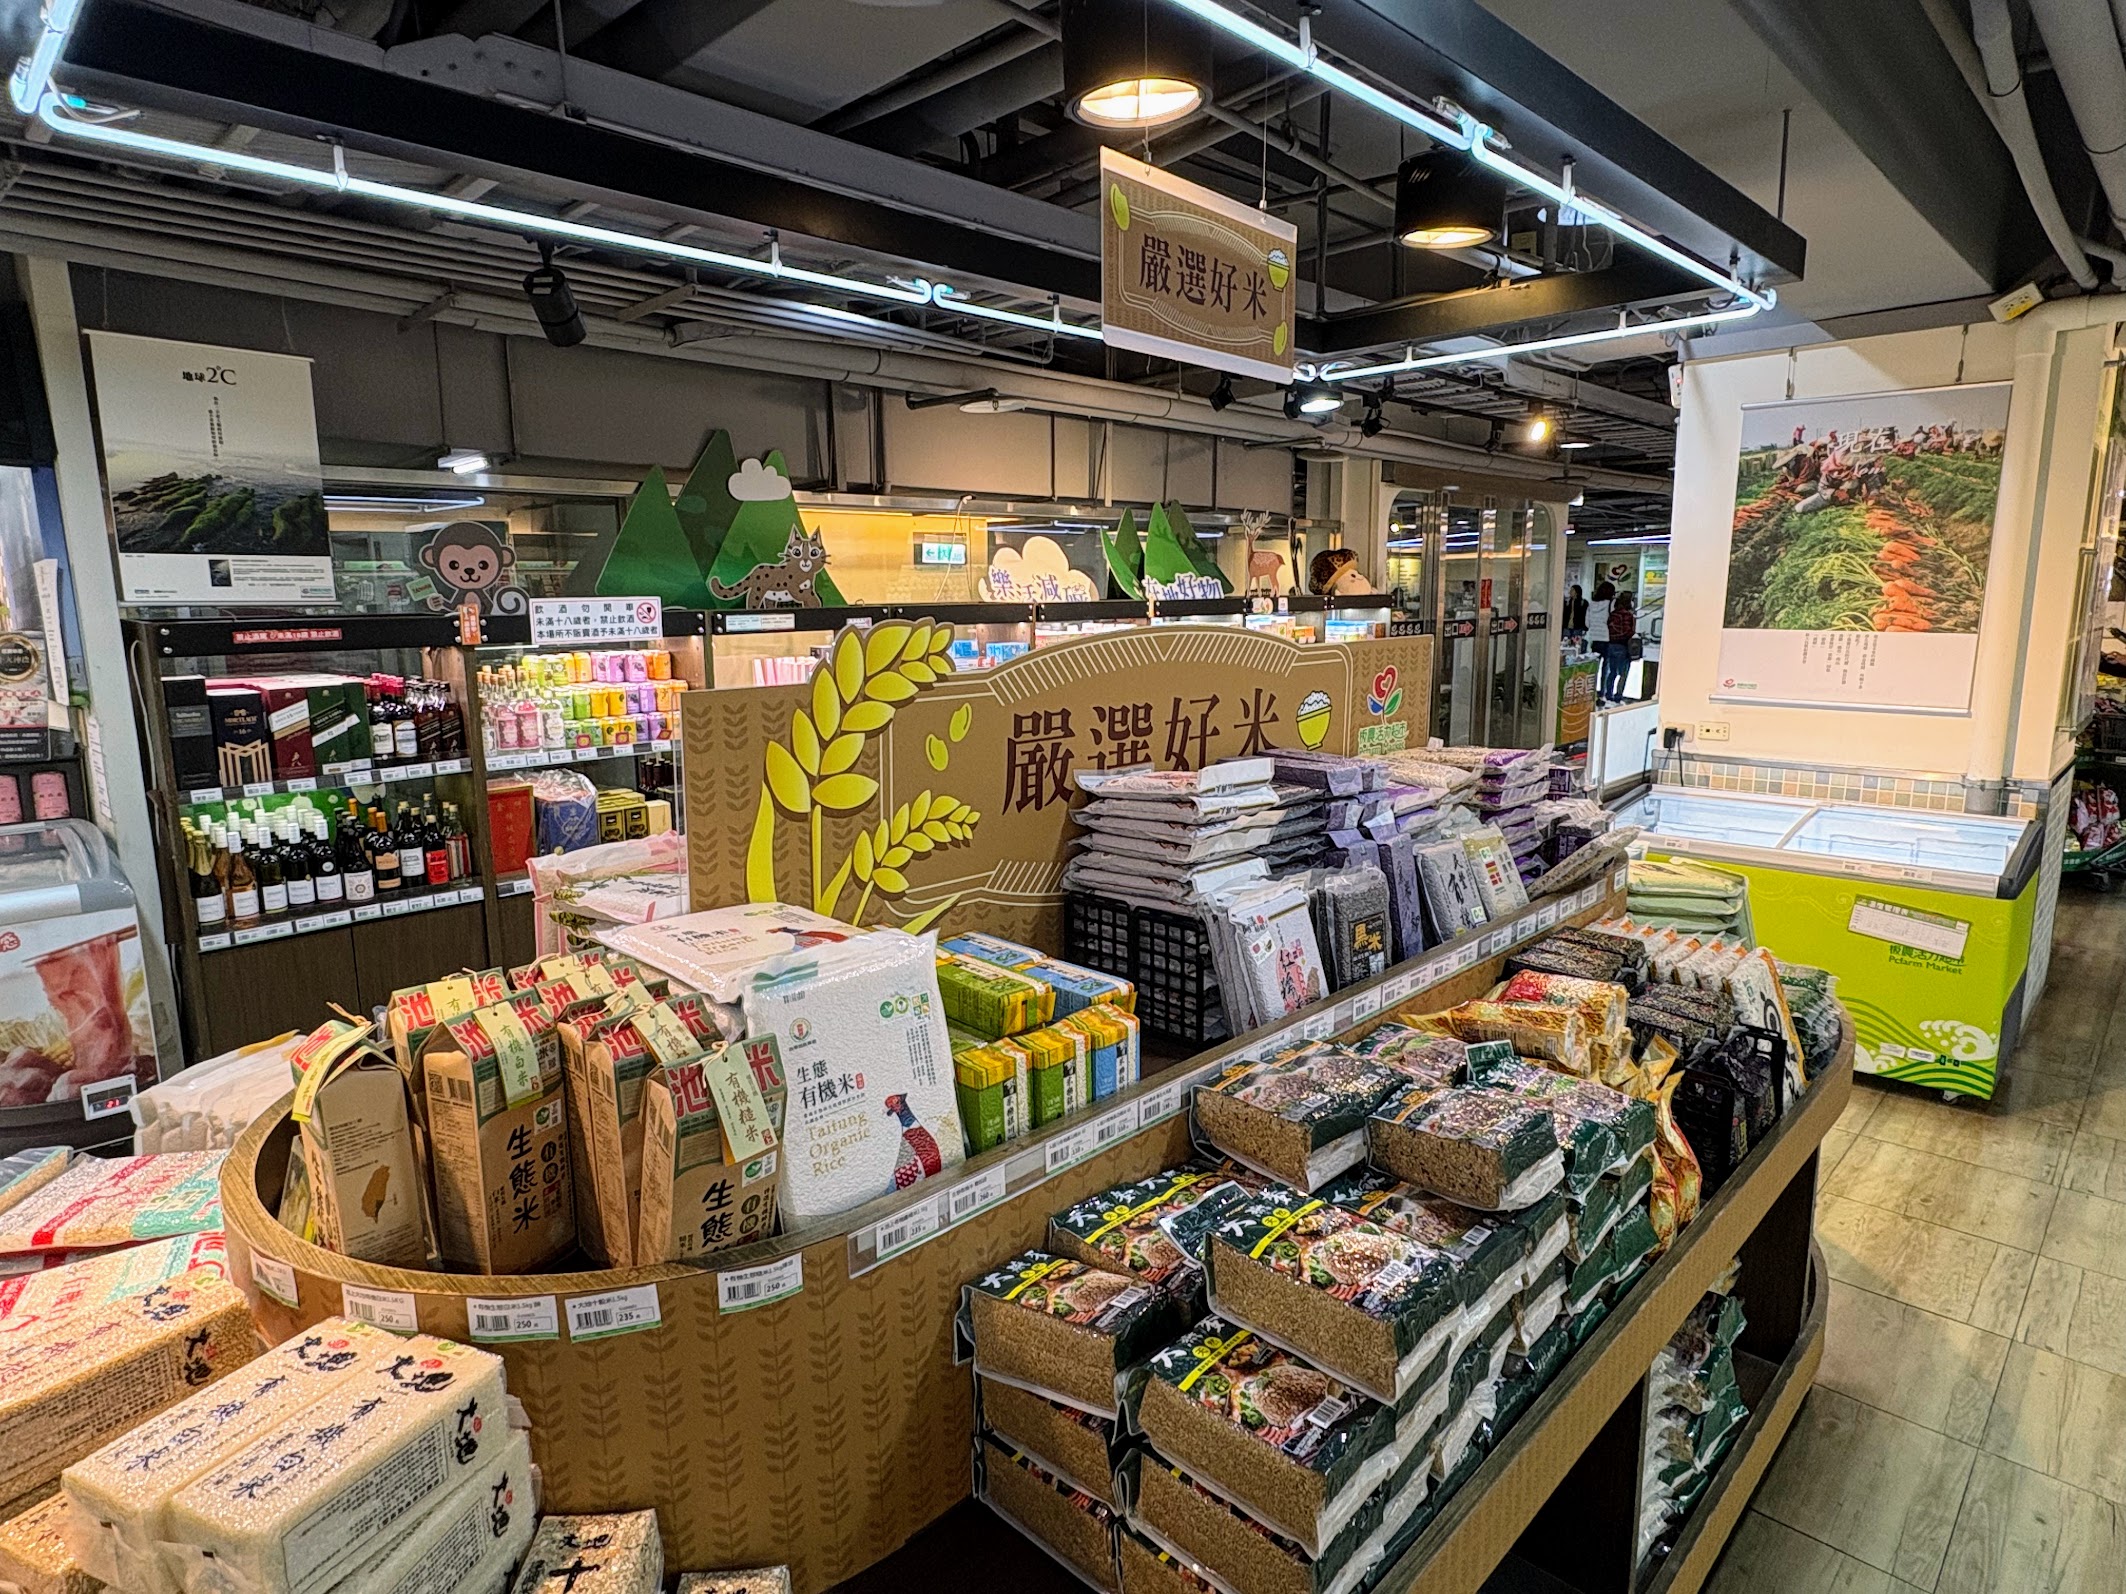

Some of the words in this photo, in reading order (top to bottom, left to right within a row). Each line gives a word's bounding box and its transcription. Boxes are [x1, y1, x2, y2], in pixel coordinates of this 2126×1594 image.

[1140, 232, 1267, 320] 嚴選好米
[1002, 688, 1280, 816] 嚴選好米
[1353, 923, 1384, 951] 黑米
[1926, 962, 1963, 975] Market
[499, 1024, 530, 1089] 有機白米
[796, 1059, 829, 1086] 生態
[668, 1065, 714, 1118] 池
[747, 1043, 782, 1092] 米
[799, 1072, 856, 1110] 有機米
[725, 1072, 760, 1143] 有機糙米
[805, 1112, 871, 1143] Taitung
[808, 1127, 872, 1161] Organic
[506, 1124, 541, 1235] 生態米
[811, 1156, 846, 1179] Rice
[767, 1282, 781, 1293] 250
[380, 1314, 394, 1323] 250
[618, 1312, 634, 1322] 235
